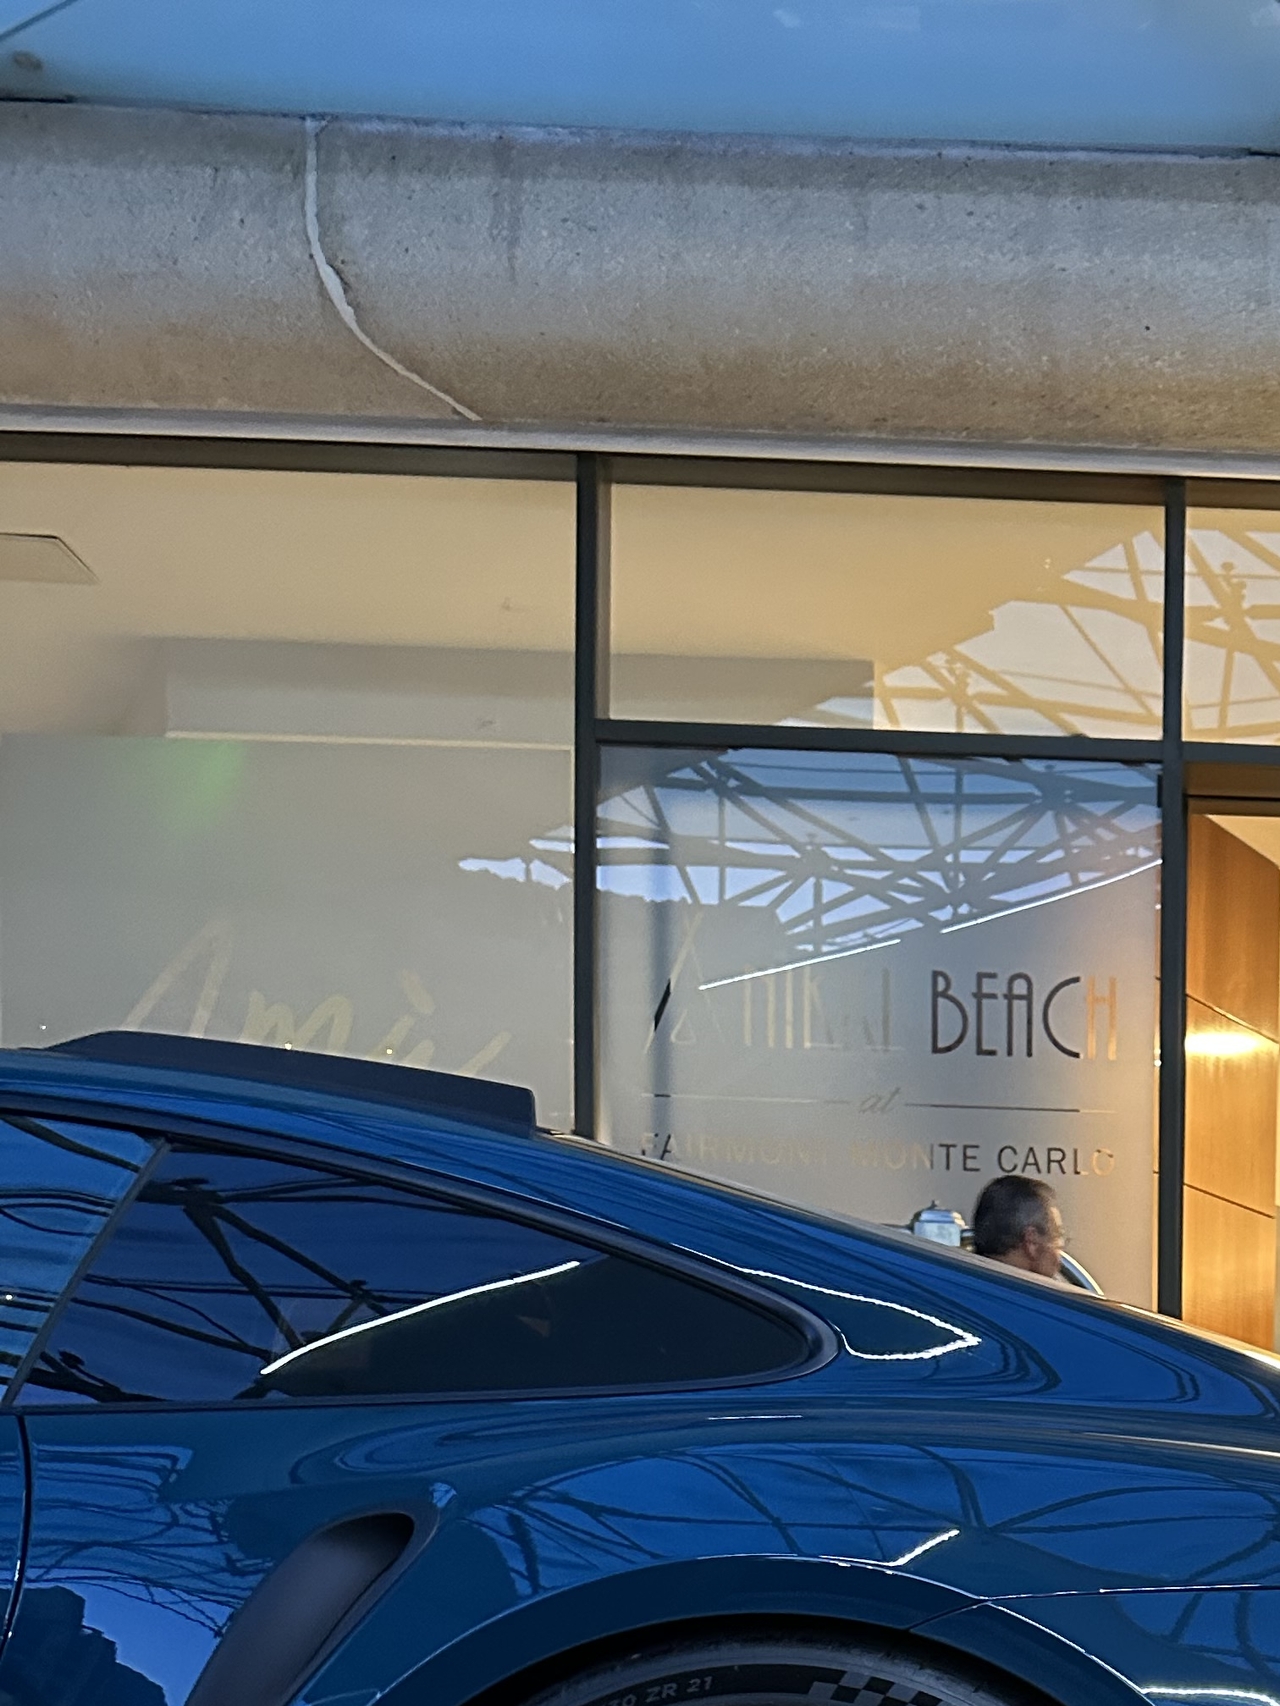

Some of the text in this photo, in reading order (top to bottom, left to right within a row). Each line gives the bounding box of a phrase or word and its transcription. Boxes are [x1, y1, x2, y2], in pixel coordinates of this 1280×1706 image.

[931, 970, 1118, 1060] BEACH
[849, 1138, 981, 1173] MONTE
[996, 1145, 1115, 1175] CARLO
[644, 1682, 680, 1705] ZR
[686, 1675, 714, 1696] 21
